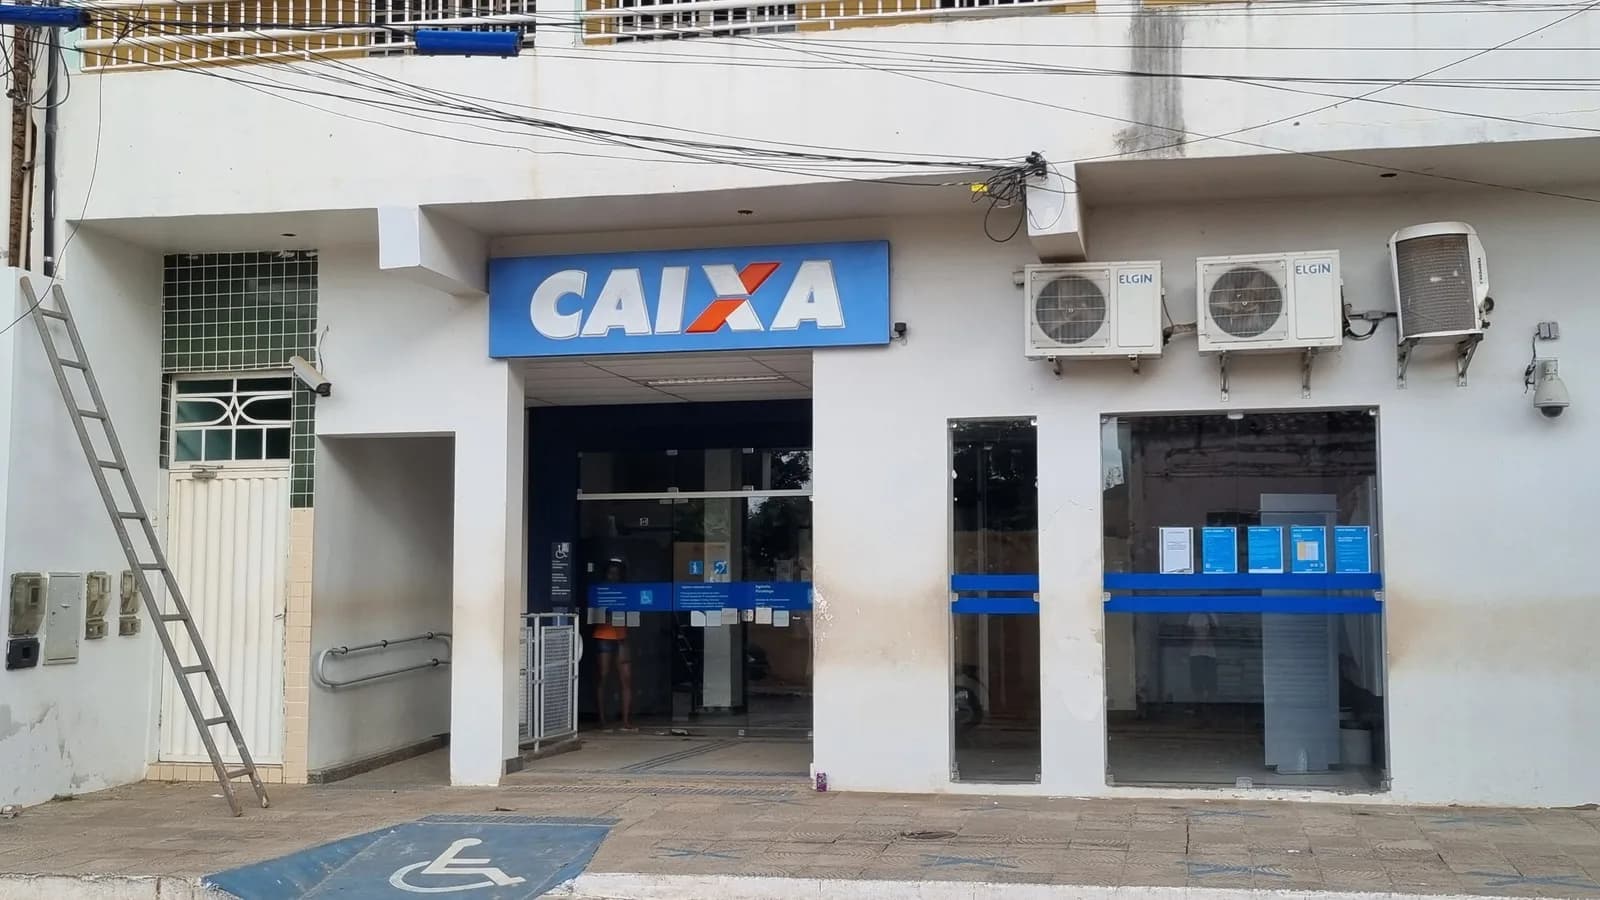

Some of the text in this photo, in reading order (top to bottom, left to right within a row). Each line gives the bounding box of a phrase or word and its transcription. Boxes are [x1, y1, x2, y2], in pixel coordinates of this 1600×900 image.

[1295, 263, 1331, 275] ELGIN
[1119, 273, 1153, 285] ELGIN
[530, 259, 846, 340] CAIXA
